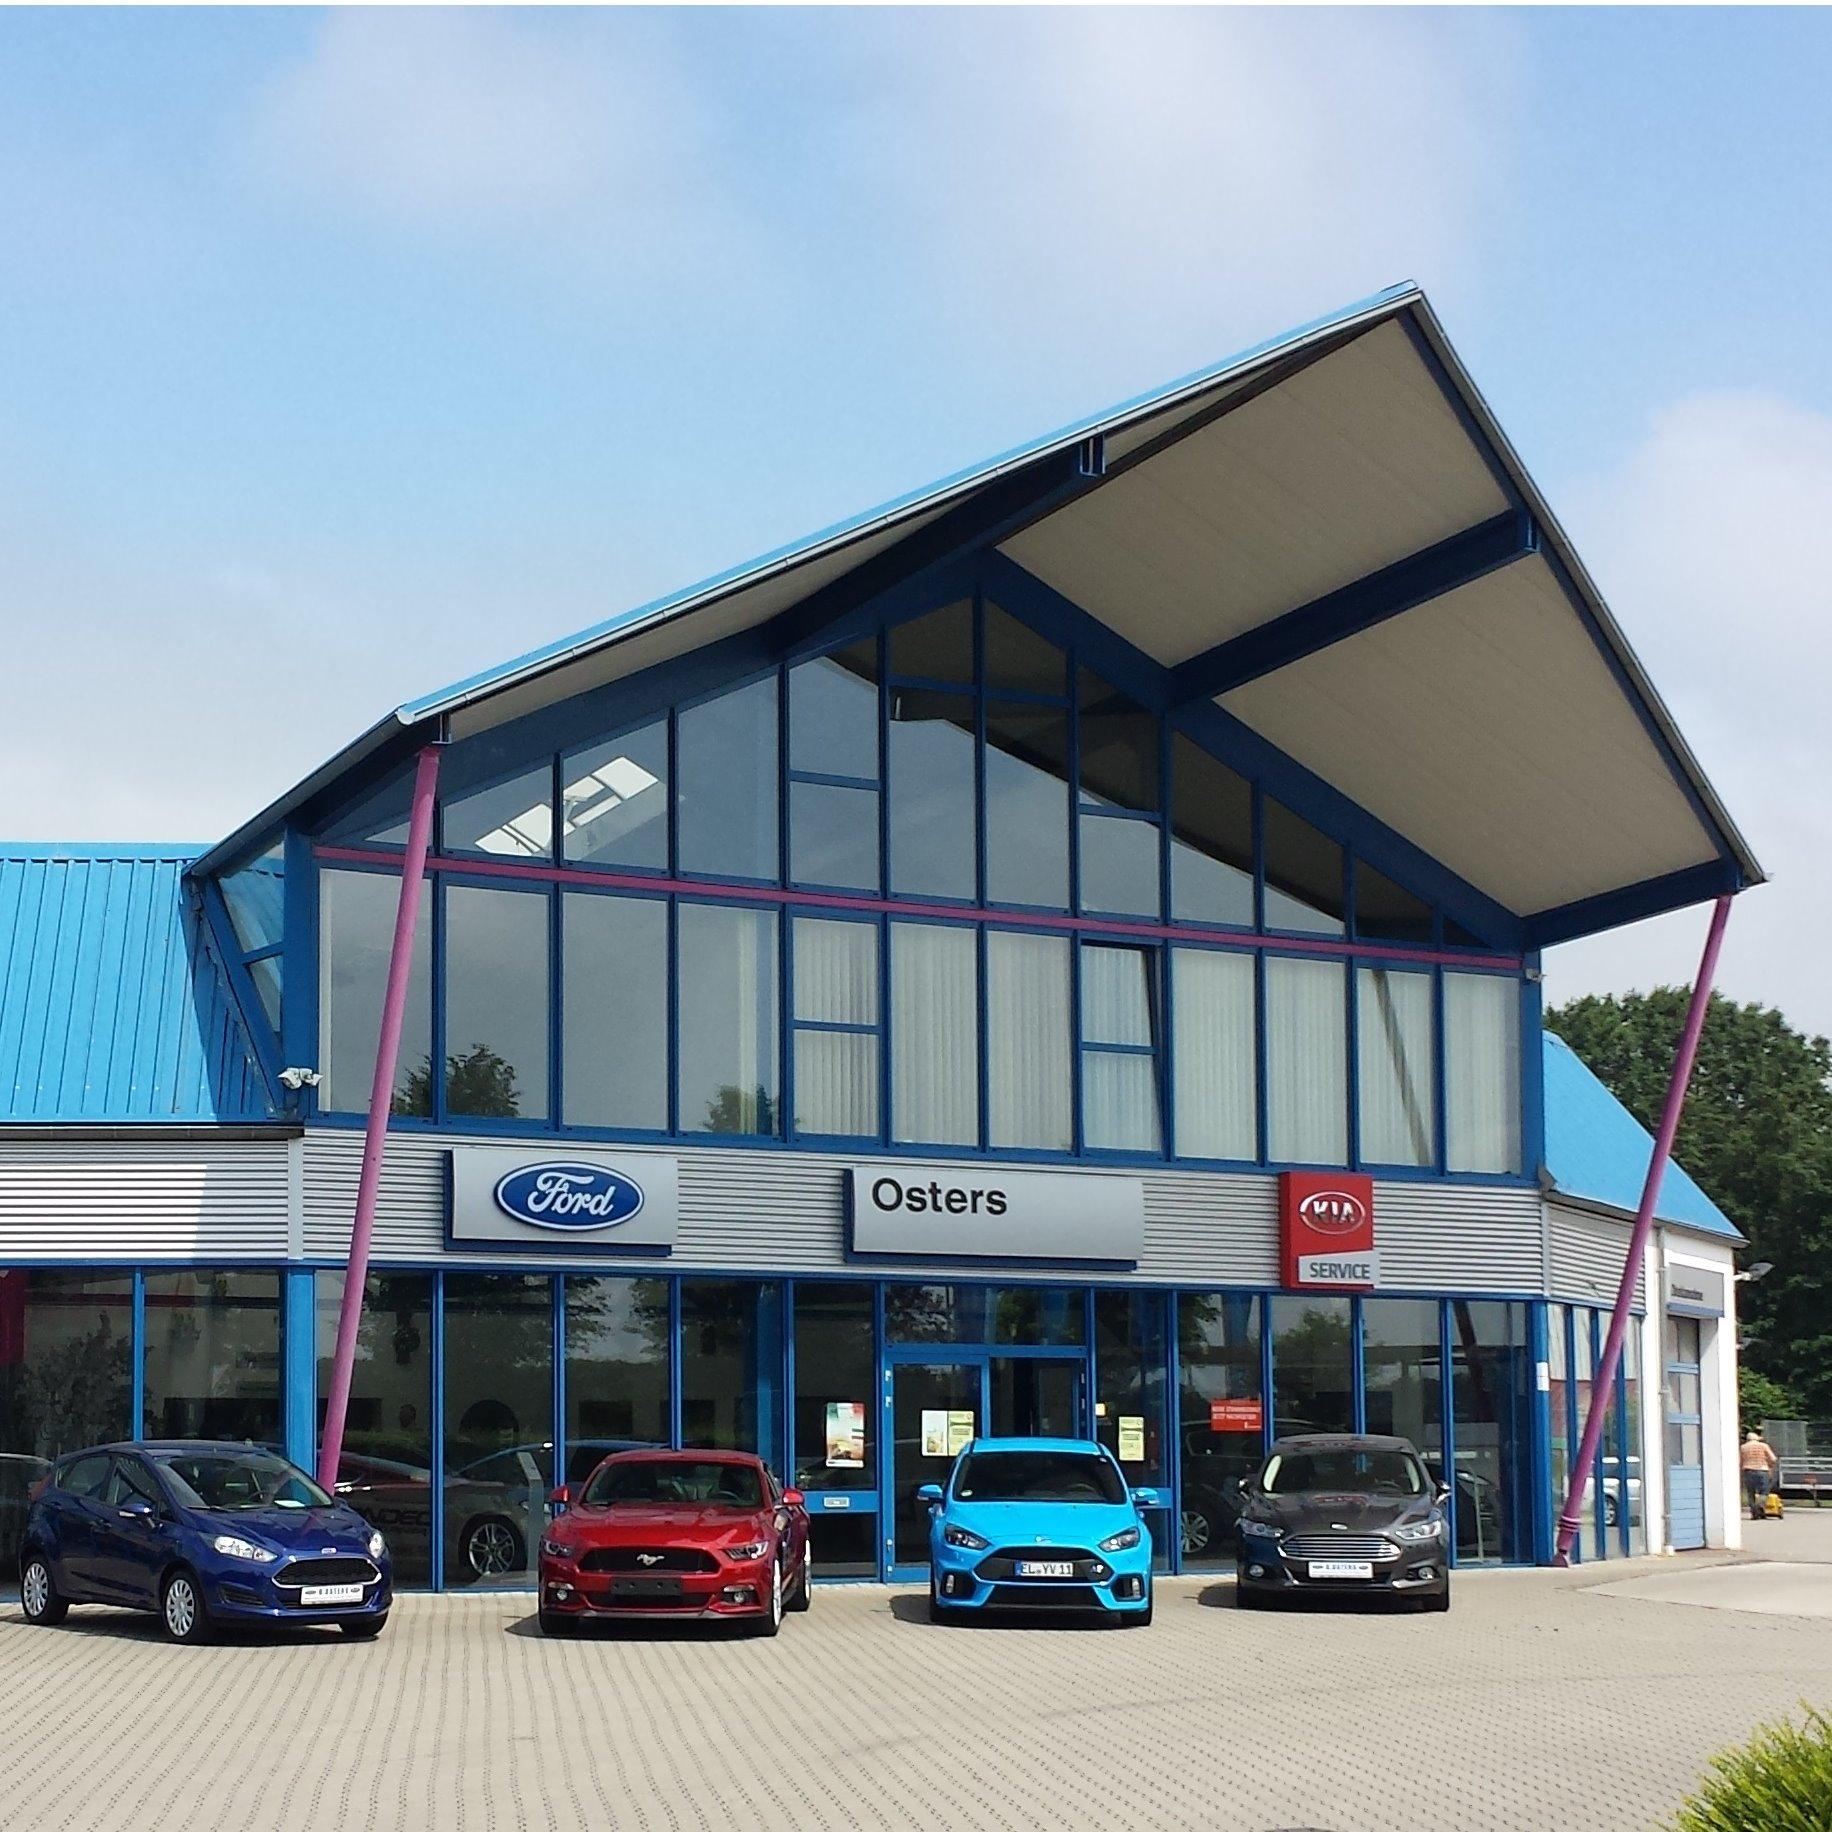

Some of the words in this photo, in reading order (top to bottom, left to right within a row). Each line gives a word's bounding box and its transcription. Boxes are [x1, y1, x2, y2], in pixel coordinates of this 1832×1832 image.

[527, 1171, 616, 1216] Ford
[872, 1177, 1007, 1215] Osters
[1313, 1200, 1355, 1223] KIA
[1309, 1262, 1370, 1279] SERVICE
[1060, 1564, 1071, 1575] 11
